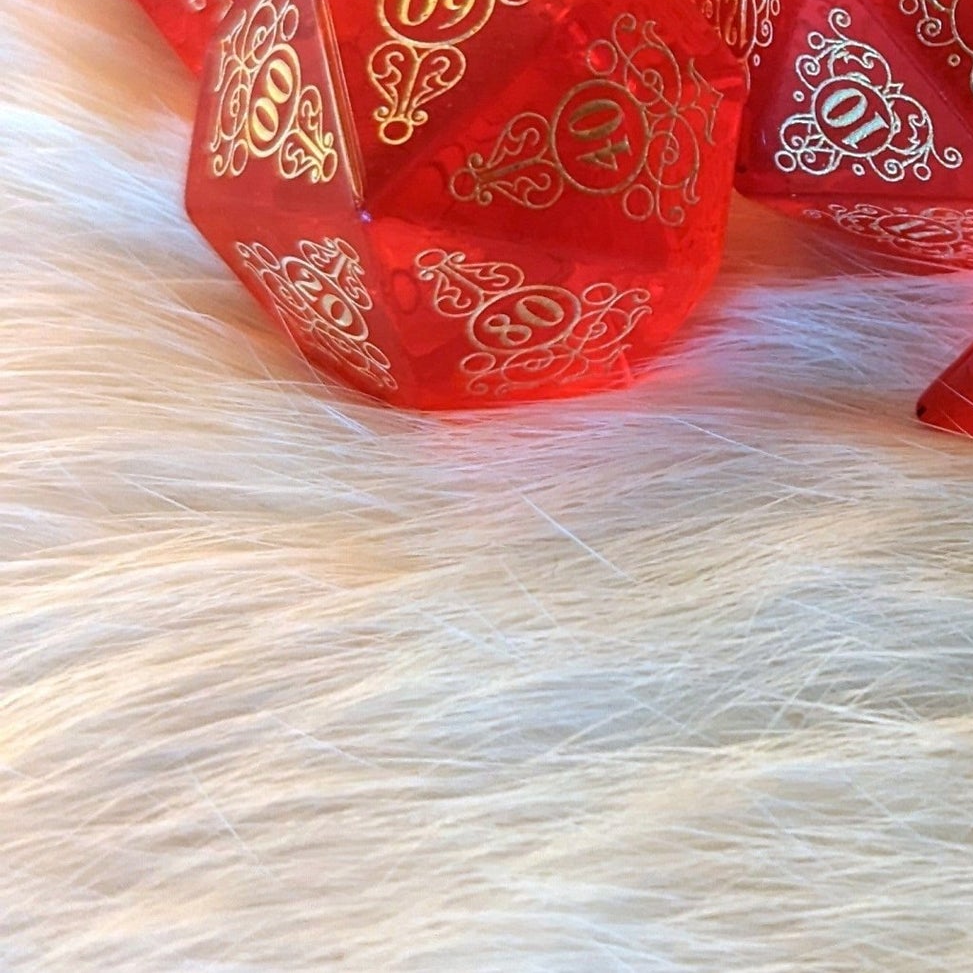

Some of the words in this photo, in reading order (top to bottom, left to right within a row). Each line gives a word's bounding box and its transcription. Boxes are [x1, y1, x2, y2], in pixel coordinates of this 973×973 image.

[252, 59, 294, 148] 00
[821, 87, 891, 149] 10
[567, 98, 633, 173] 40
[300, 273, 354, 328] 20
[486, 294, 565, 348] 80
